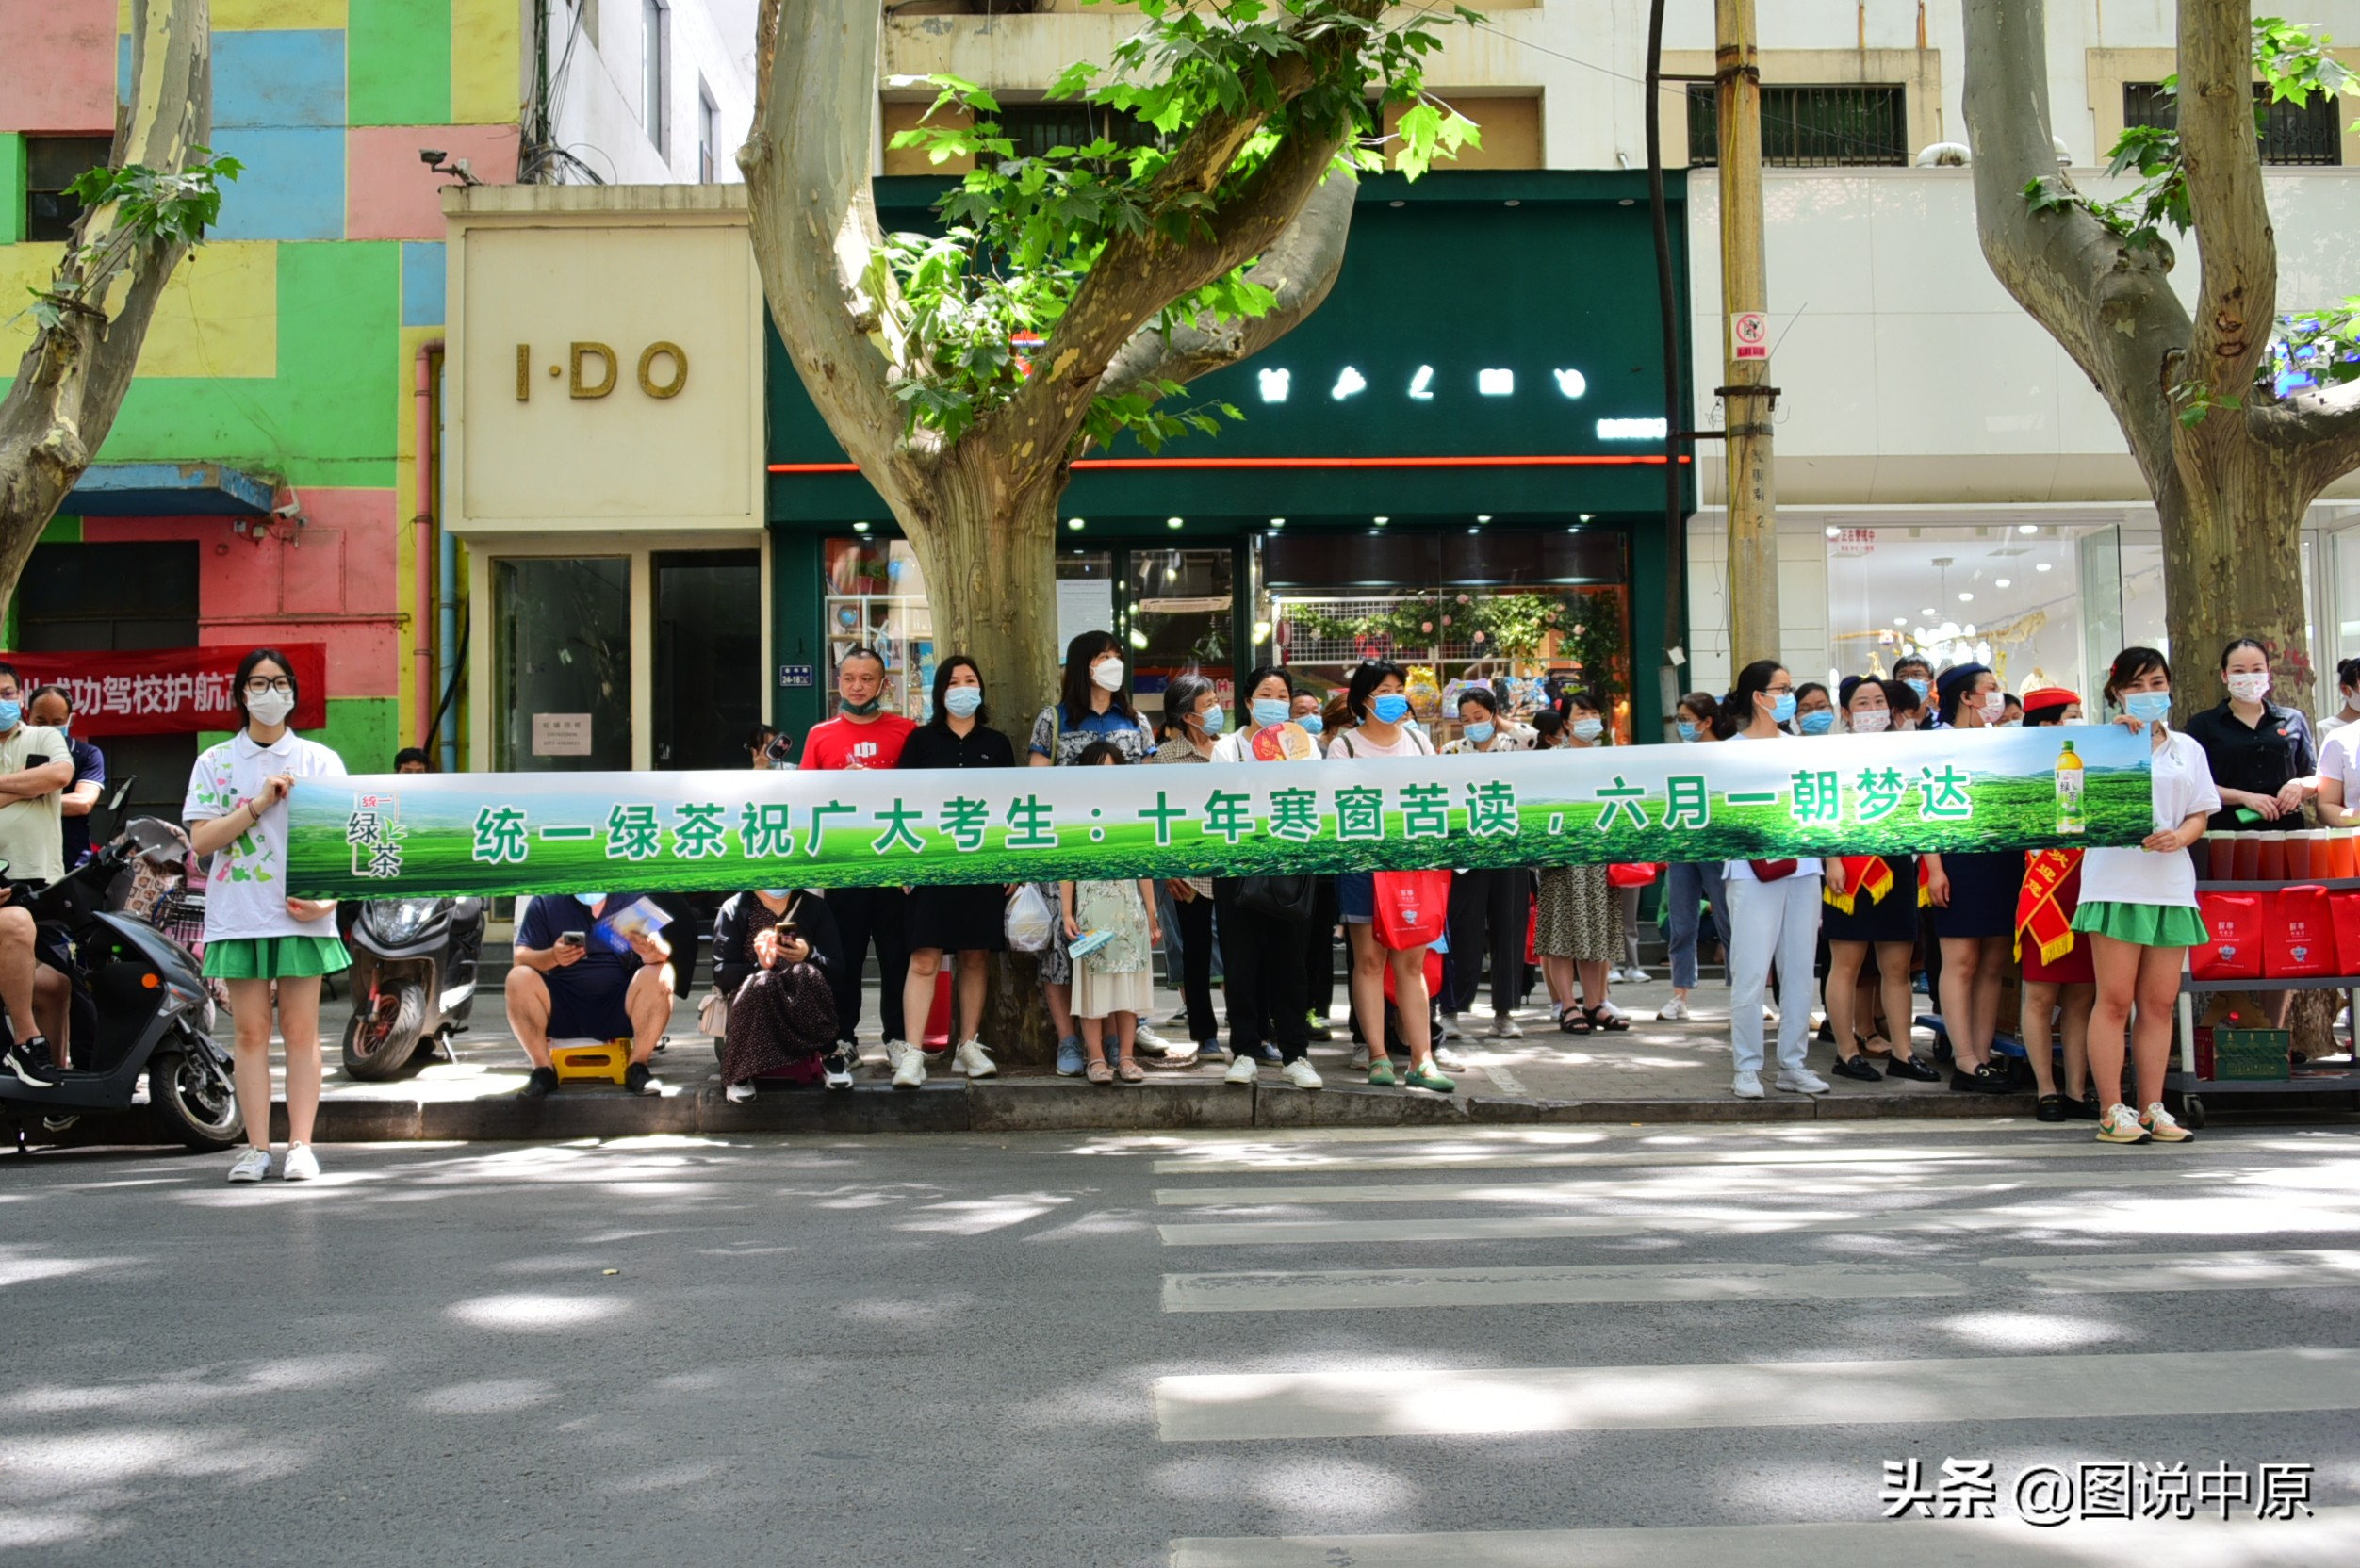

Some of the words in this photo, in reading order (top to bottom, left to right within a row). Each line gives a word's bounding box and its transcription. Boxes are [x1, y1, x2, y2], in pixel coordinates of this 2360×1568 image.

[24, 671, 236, 716] 功驾校护航
[348, 811, 402, 877] 绿茶
